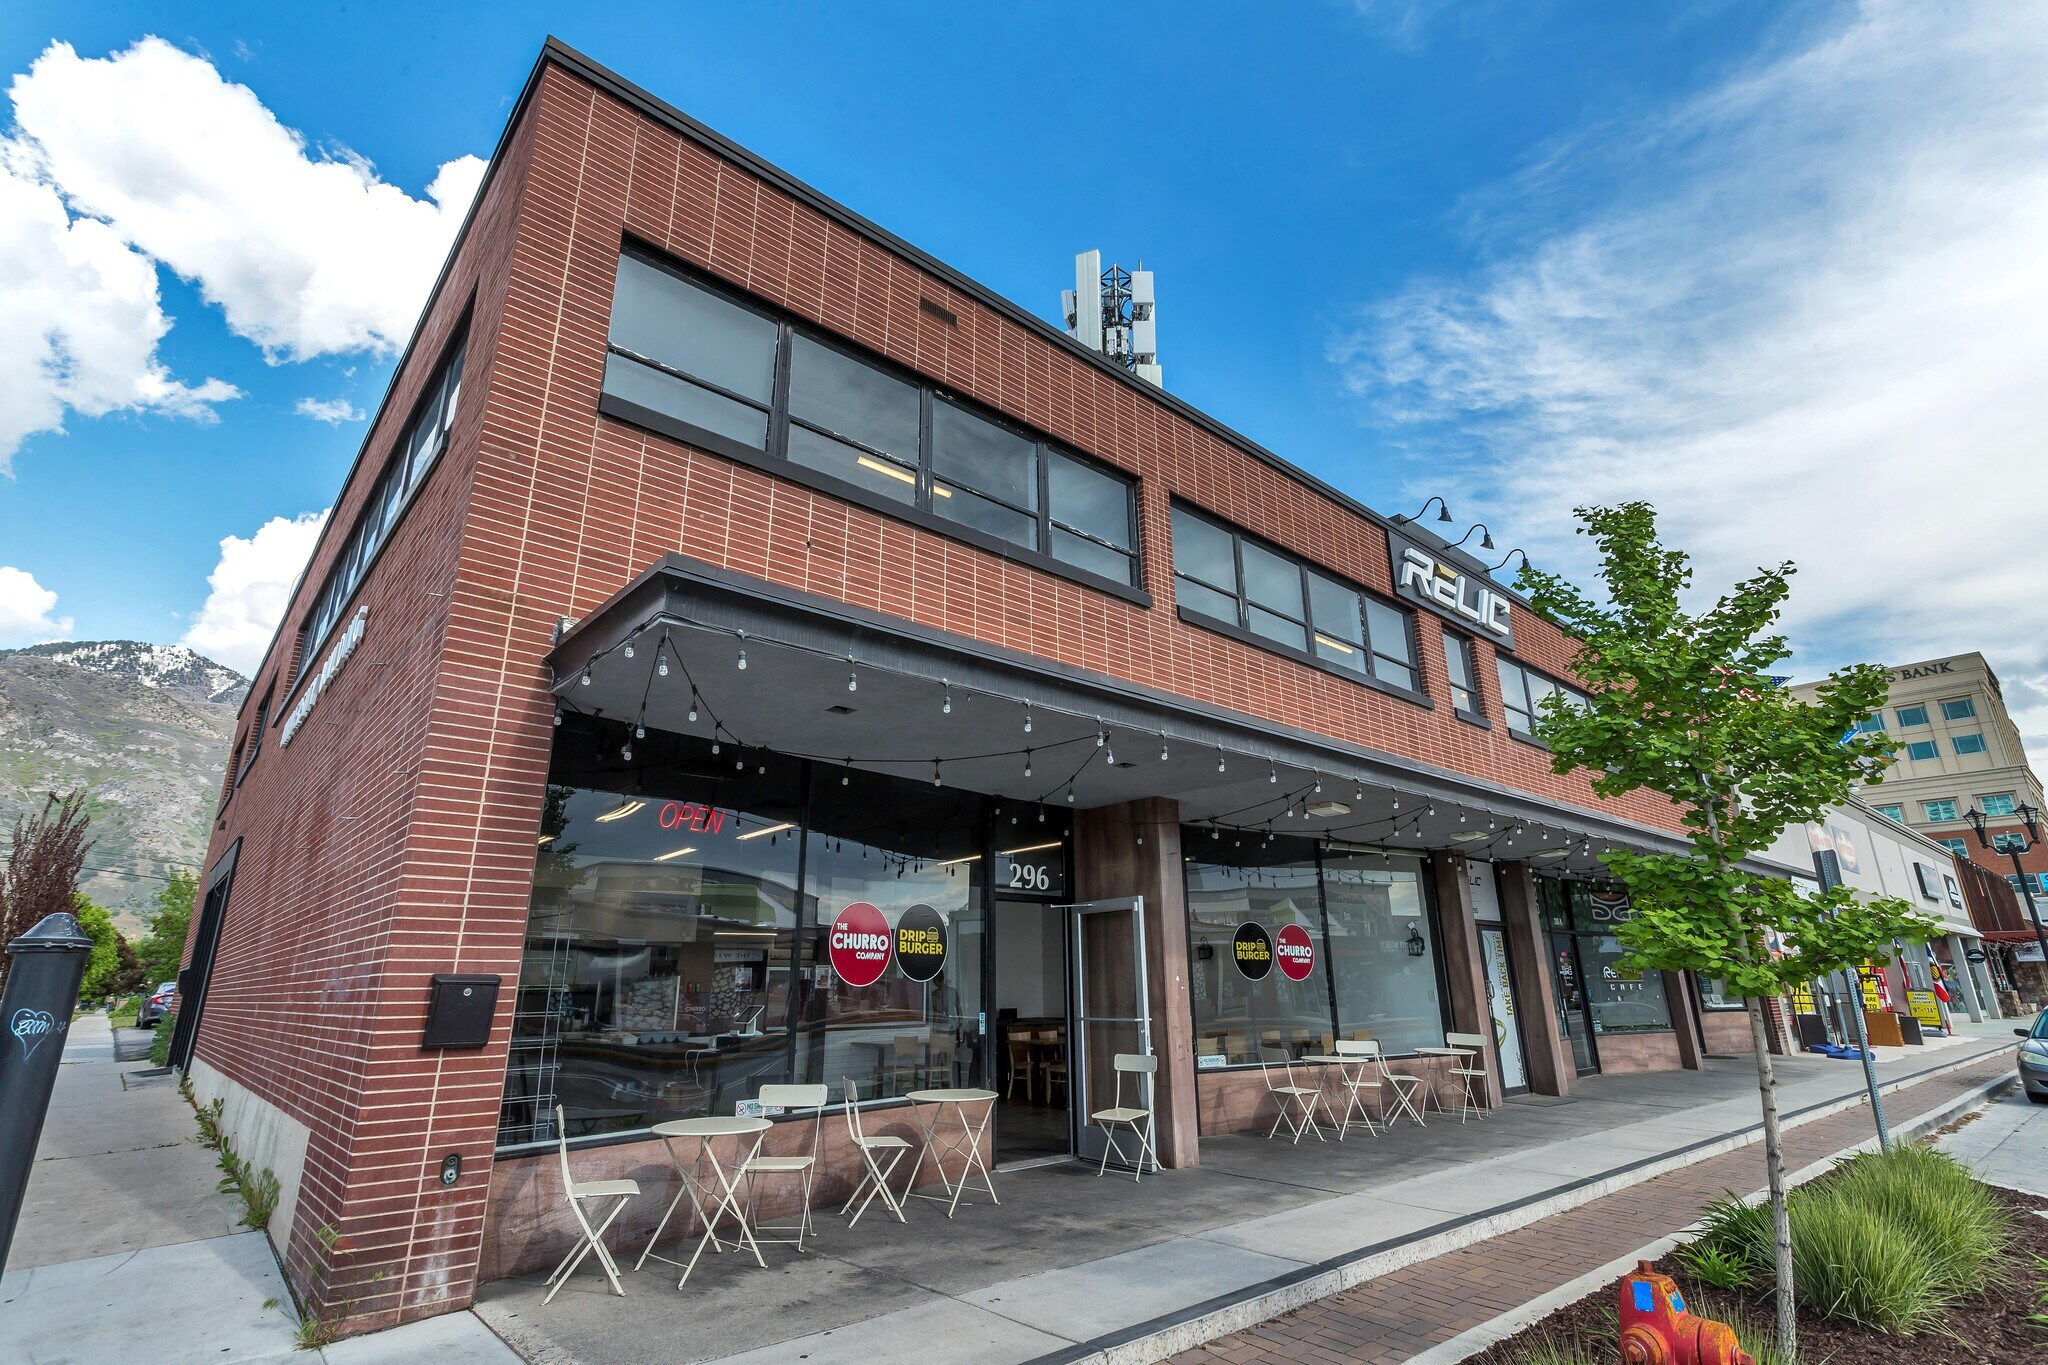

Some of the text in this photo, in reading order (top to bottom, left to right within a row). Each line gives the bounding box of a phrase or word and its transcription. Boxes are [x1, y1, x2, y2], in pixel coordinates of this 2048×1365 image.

[1400, 547, 1511, 637] RELIC
[1901, 661, 1955, 681] BANK
[660, 801, 726, 834] OPEN
[1009, 863, 1049, 890] 296
[836, 922, 848, 931] THE
[900, 929, 926, 942] DRIP
[832, 932, 889, 952] CHURRO
[899, 941, 943, 955] BURGER
[1235, 941, 1257, 951] DRIP
[1277, 945, 1312, 958] CHURRO
[1495, 933, 1504, 958] TIME
[855, 951, 885, 961] COMPANY
[1236, 950, 1270, 960] BURGER
[1499, 962, 1509, 988] BACK
[1504, 991, 1513, 1017] TAKE
